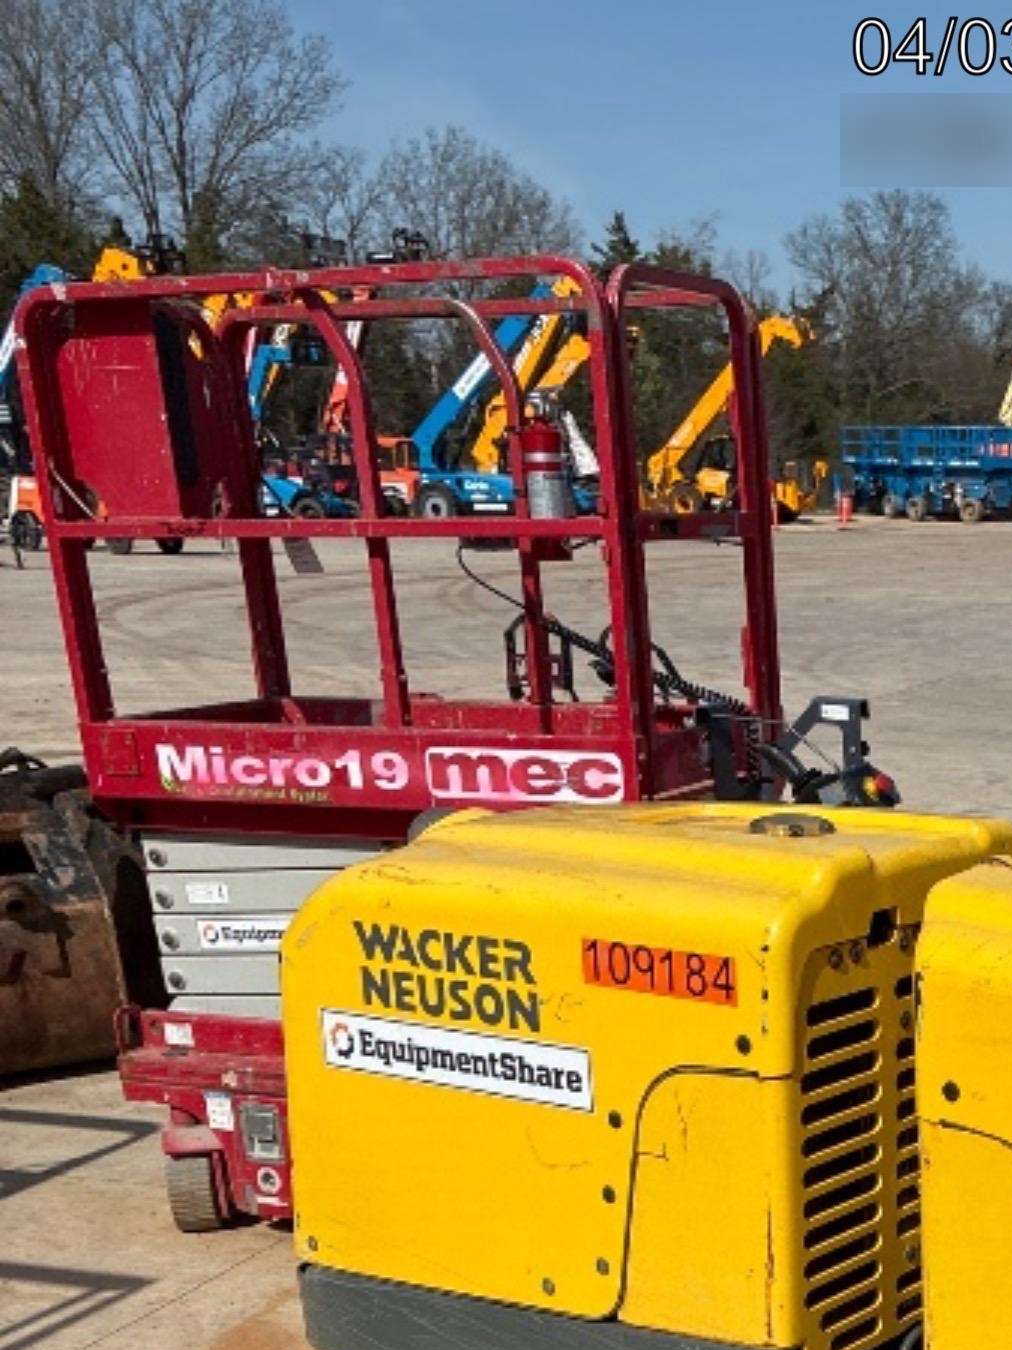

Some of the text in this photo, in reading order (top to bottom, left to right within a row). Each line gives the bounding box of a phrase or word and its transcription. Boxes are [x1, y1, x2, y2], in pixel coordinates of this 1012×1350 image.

[155, 744, 410, 790] Micro19
[427, 751, 622, 799] mec
[353, 920, 538, 986] WACKER
[583, 938, 735, 1001] 109184
[360, 966, 541, 1033] NEUSON
[358, 1028, 584, 1093] EquipmentShare
